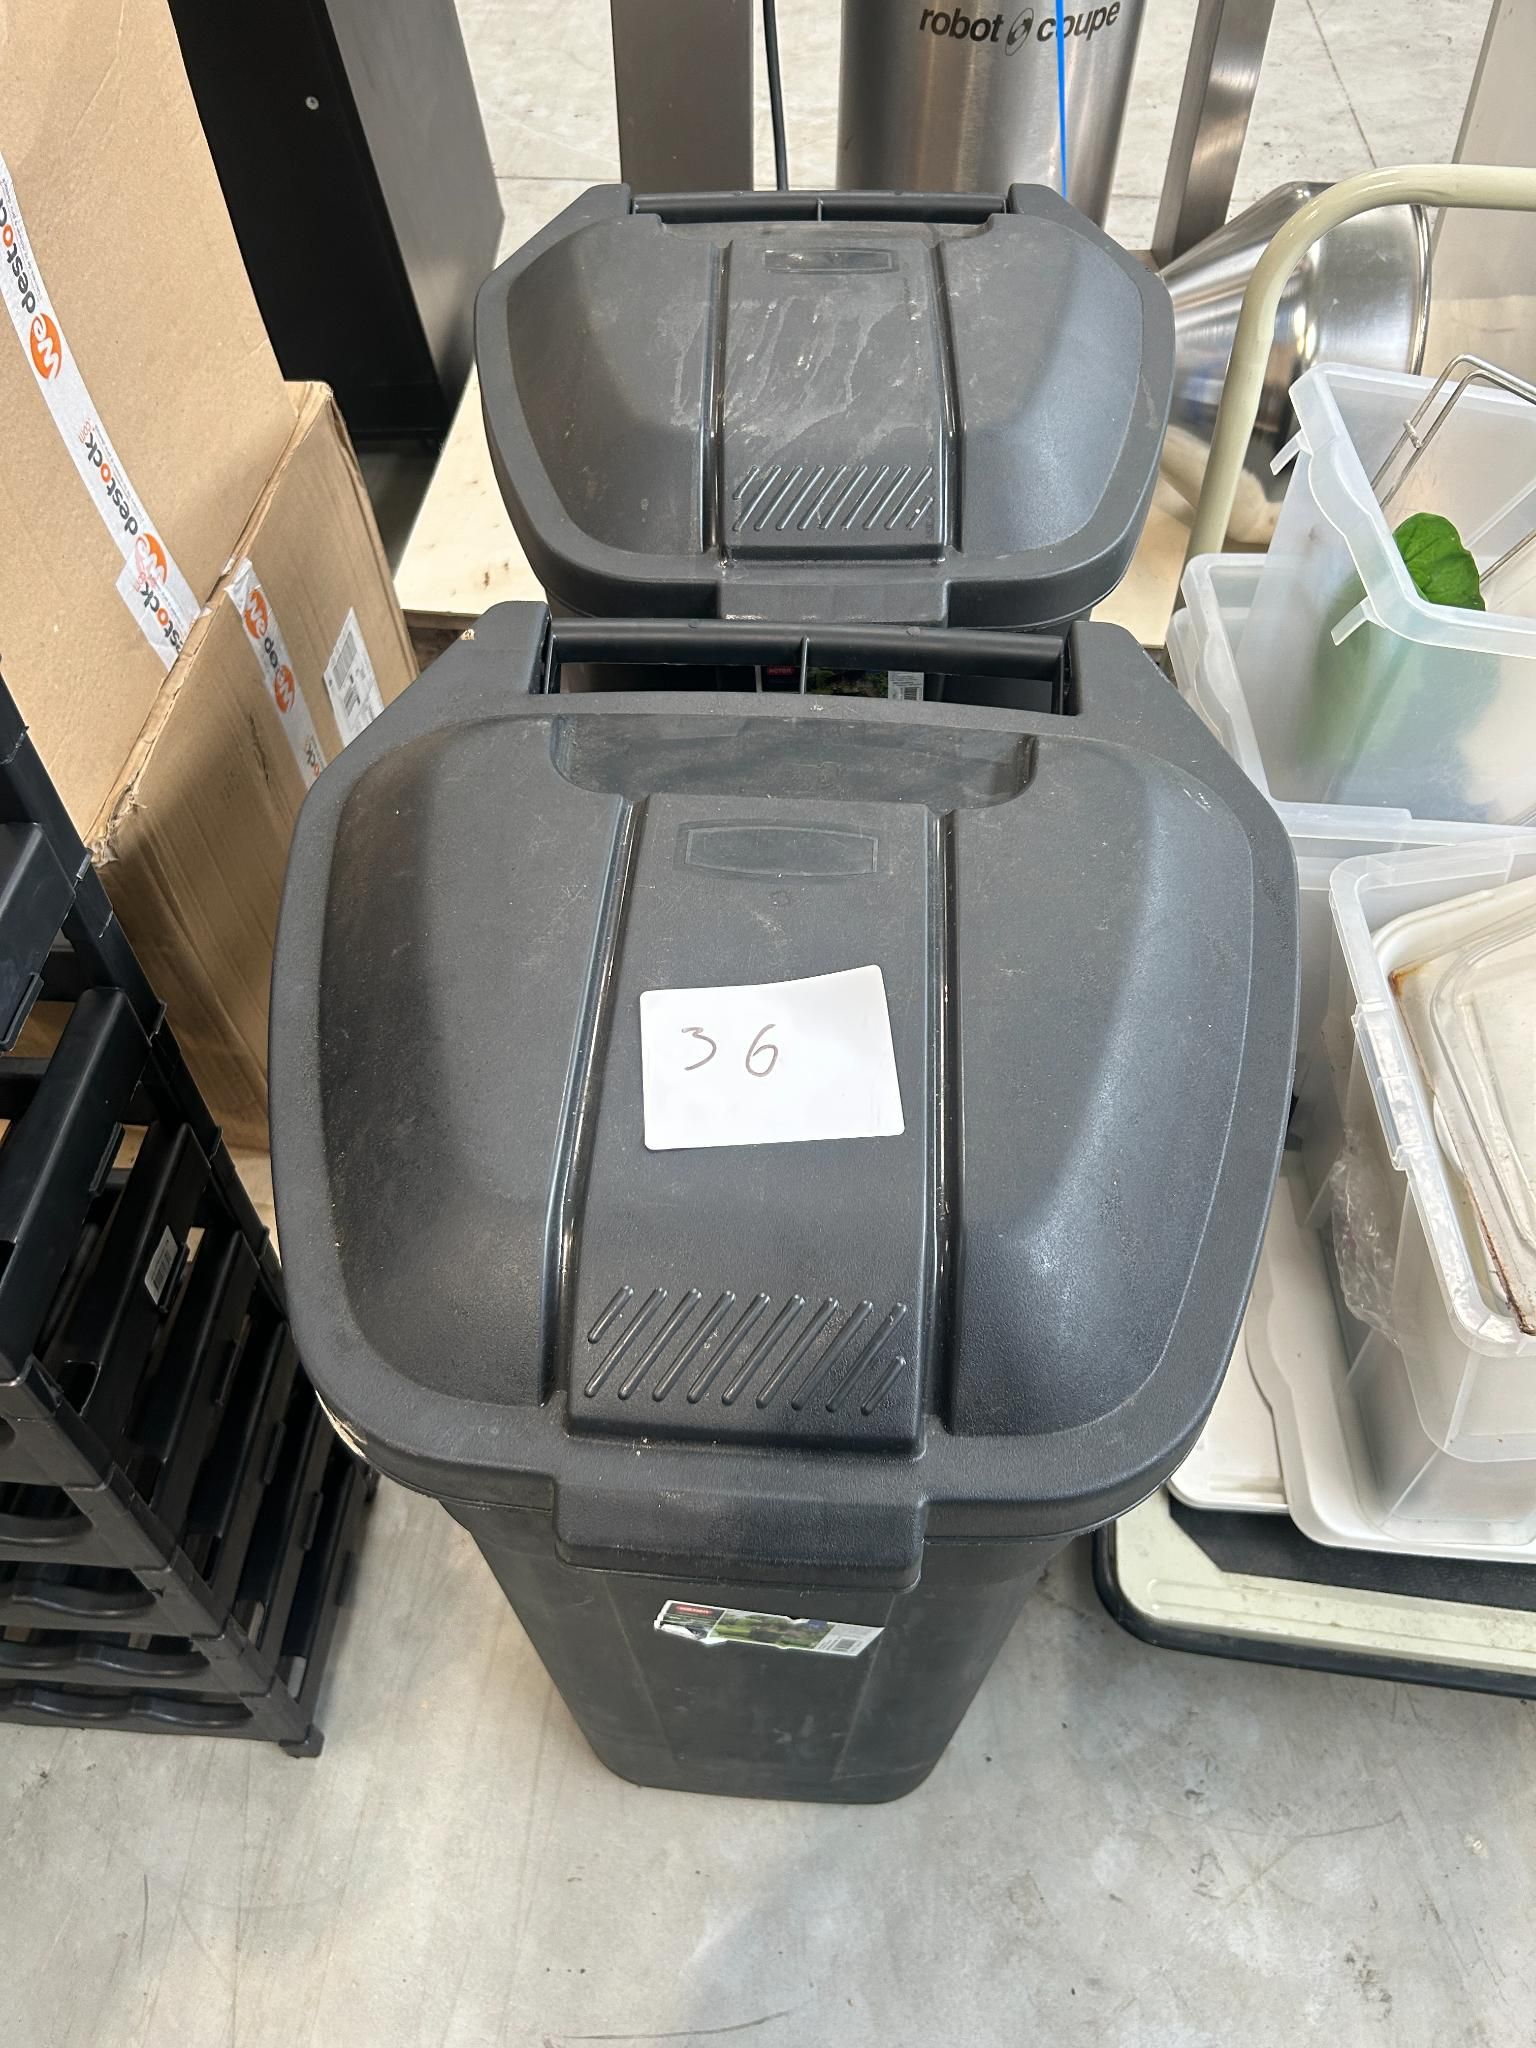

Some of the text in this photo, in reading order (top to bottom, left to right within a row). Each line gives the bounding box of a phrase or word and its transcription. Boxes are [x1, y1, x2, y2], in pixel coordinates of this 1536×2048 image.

[919, 1, 1121, 42] robot coupe
[0, 199, 35, 313] destoc
[85, 432, 138, 536] destock
